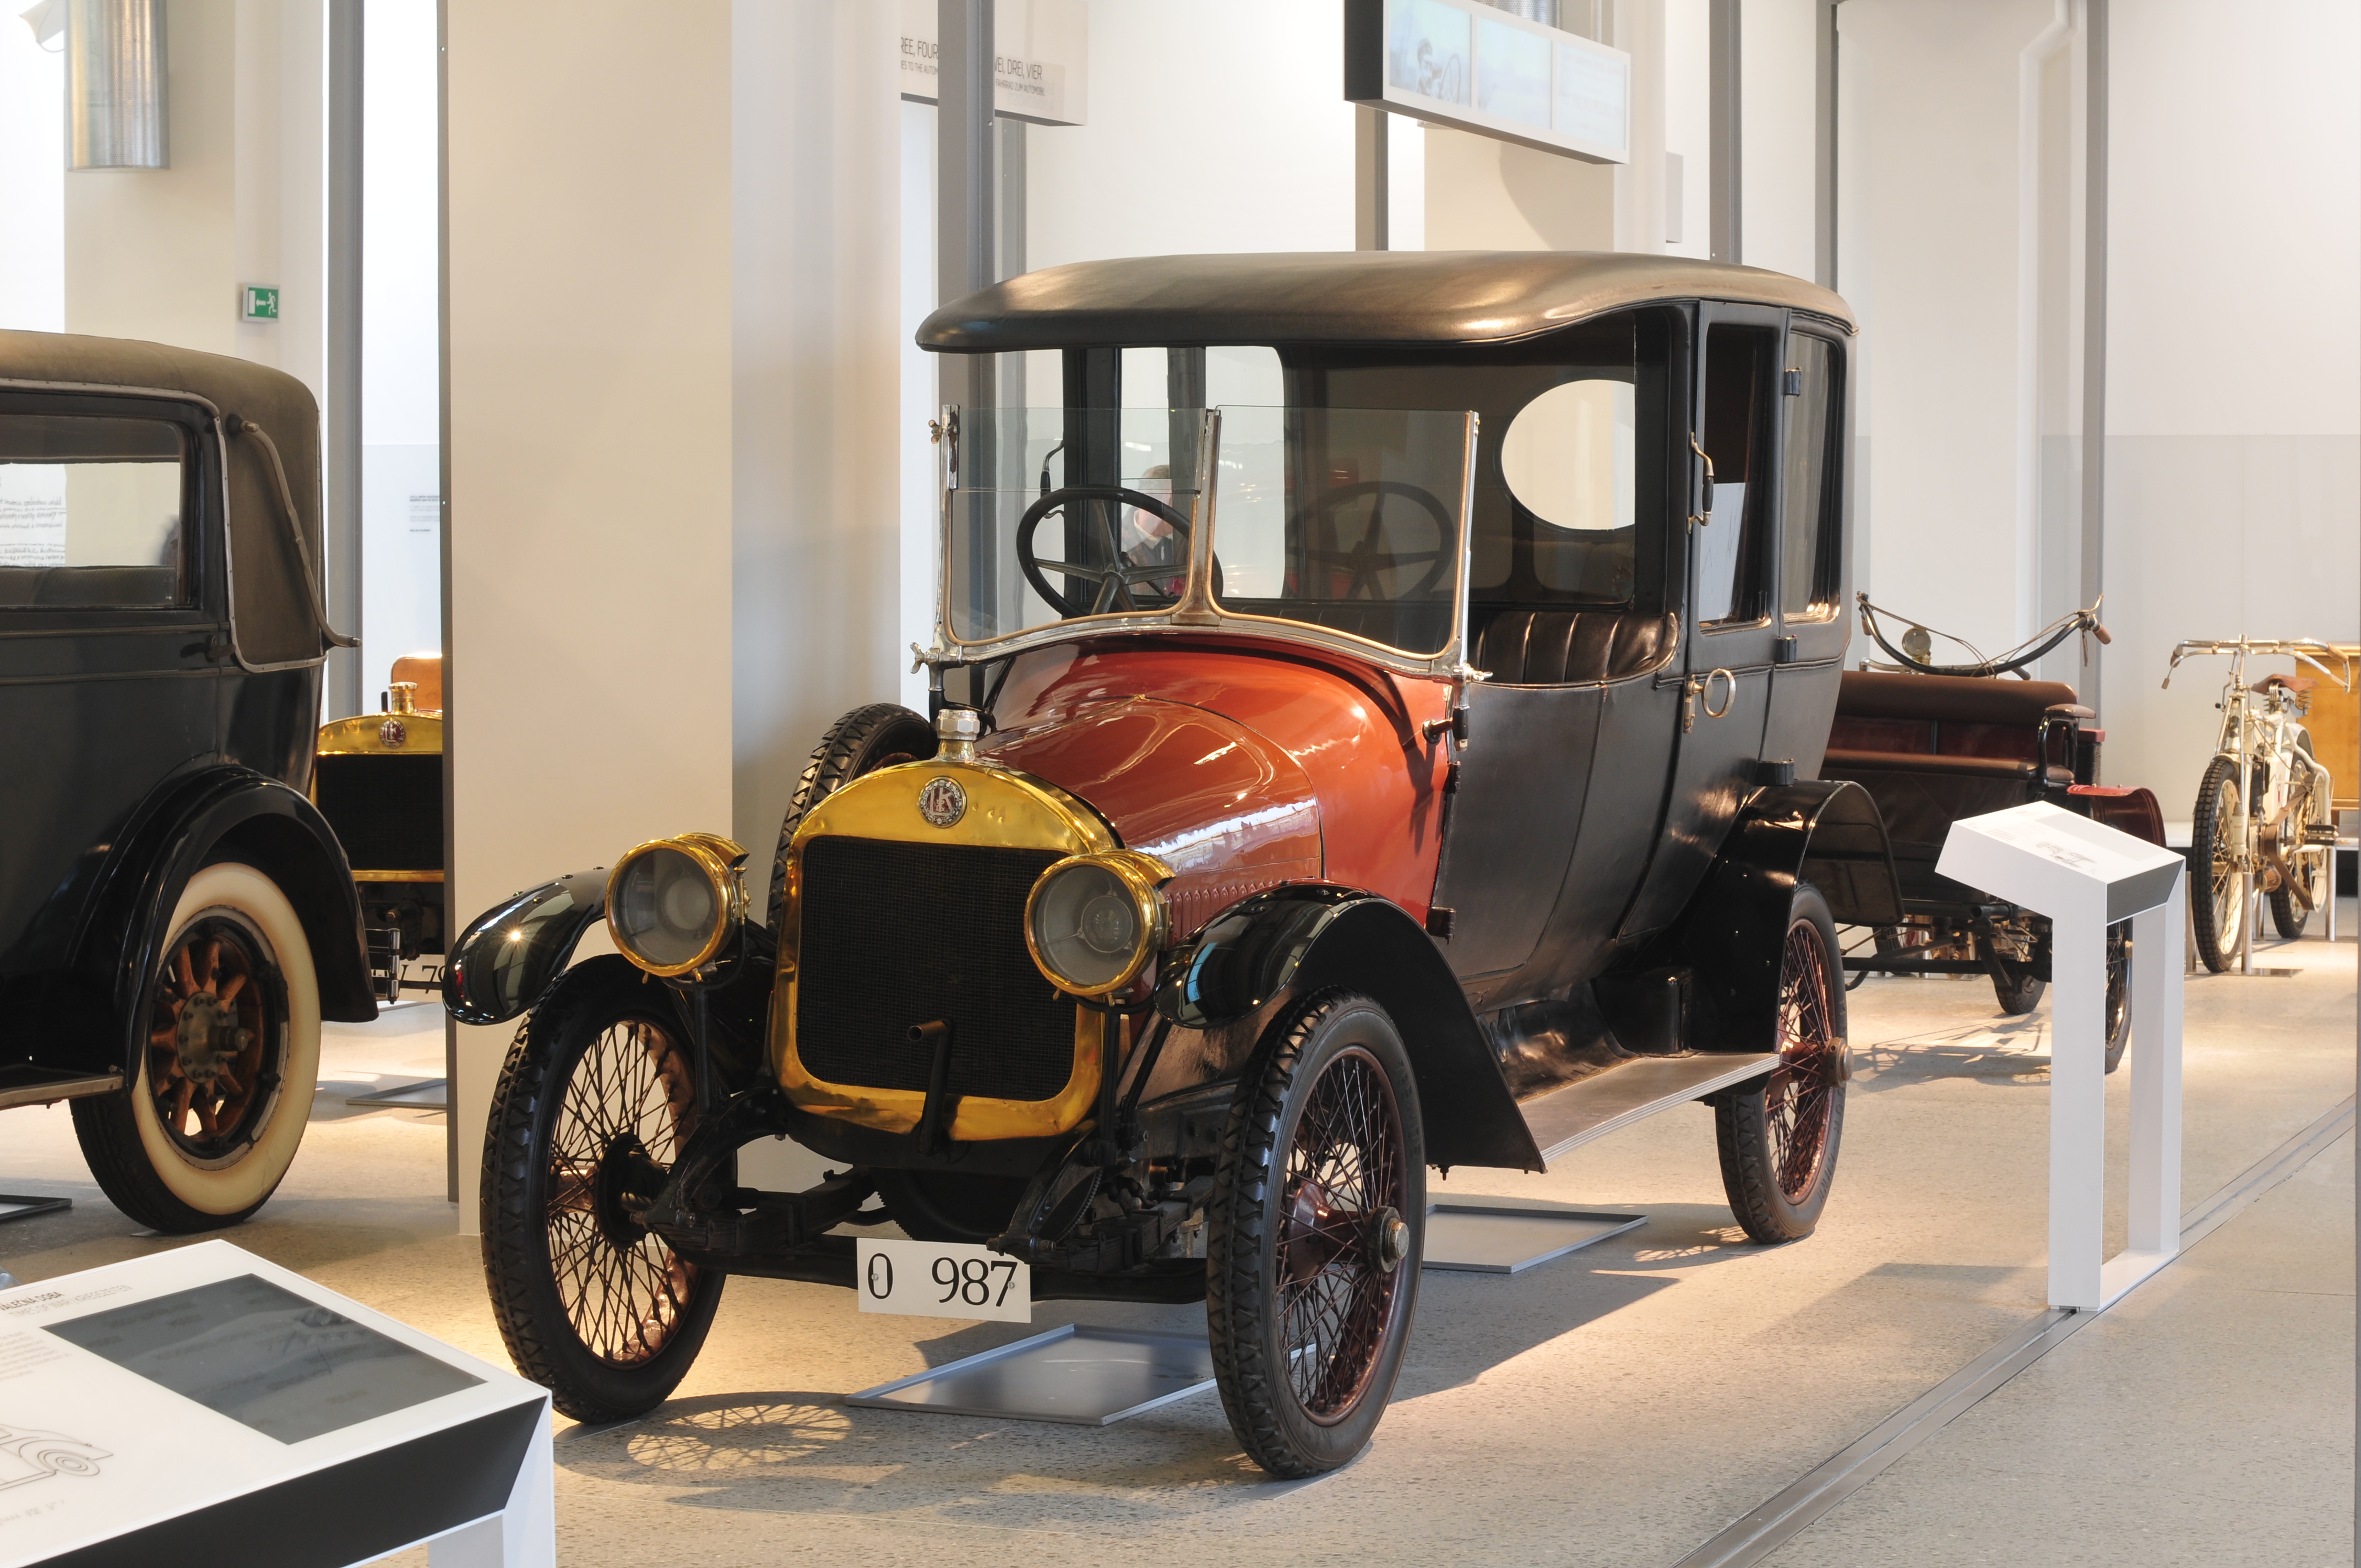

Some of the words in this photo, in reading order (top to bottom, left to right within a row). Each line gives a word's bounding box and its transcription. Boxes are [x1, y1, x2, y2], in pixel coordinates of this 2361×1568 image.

[918, 40, 938, 59] FOUR
[908, 61, 914, 71] TO
[915, 62, 923, 73] THE
[1007, 59, 1025, 79] DREI,
[1026, 63, 1042, 80] VIER
[932, 1256, 1018, 1307] 987
[35, 1291, 65, 1301] DOBA
[8, 1307, 40, 1317] TIMES
